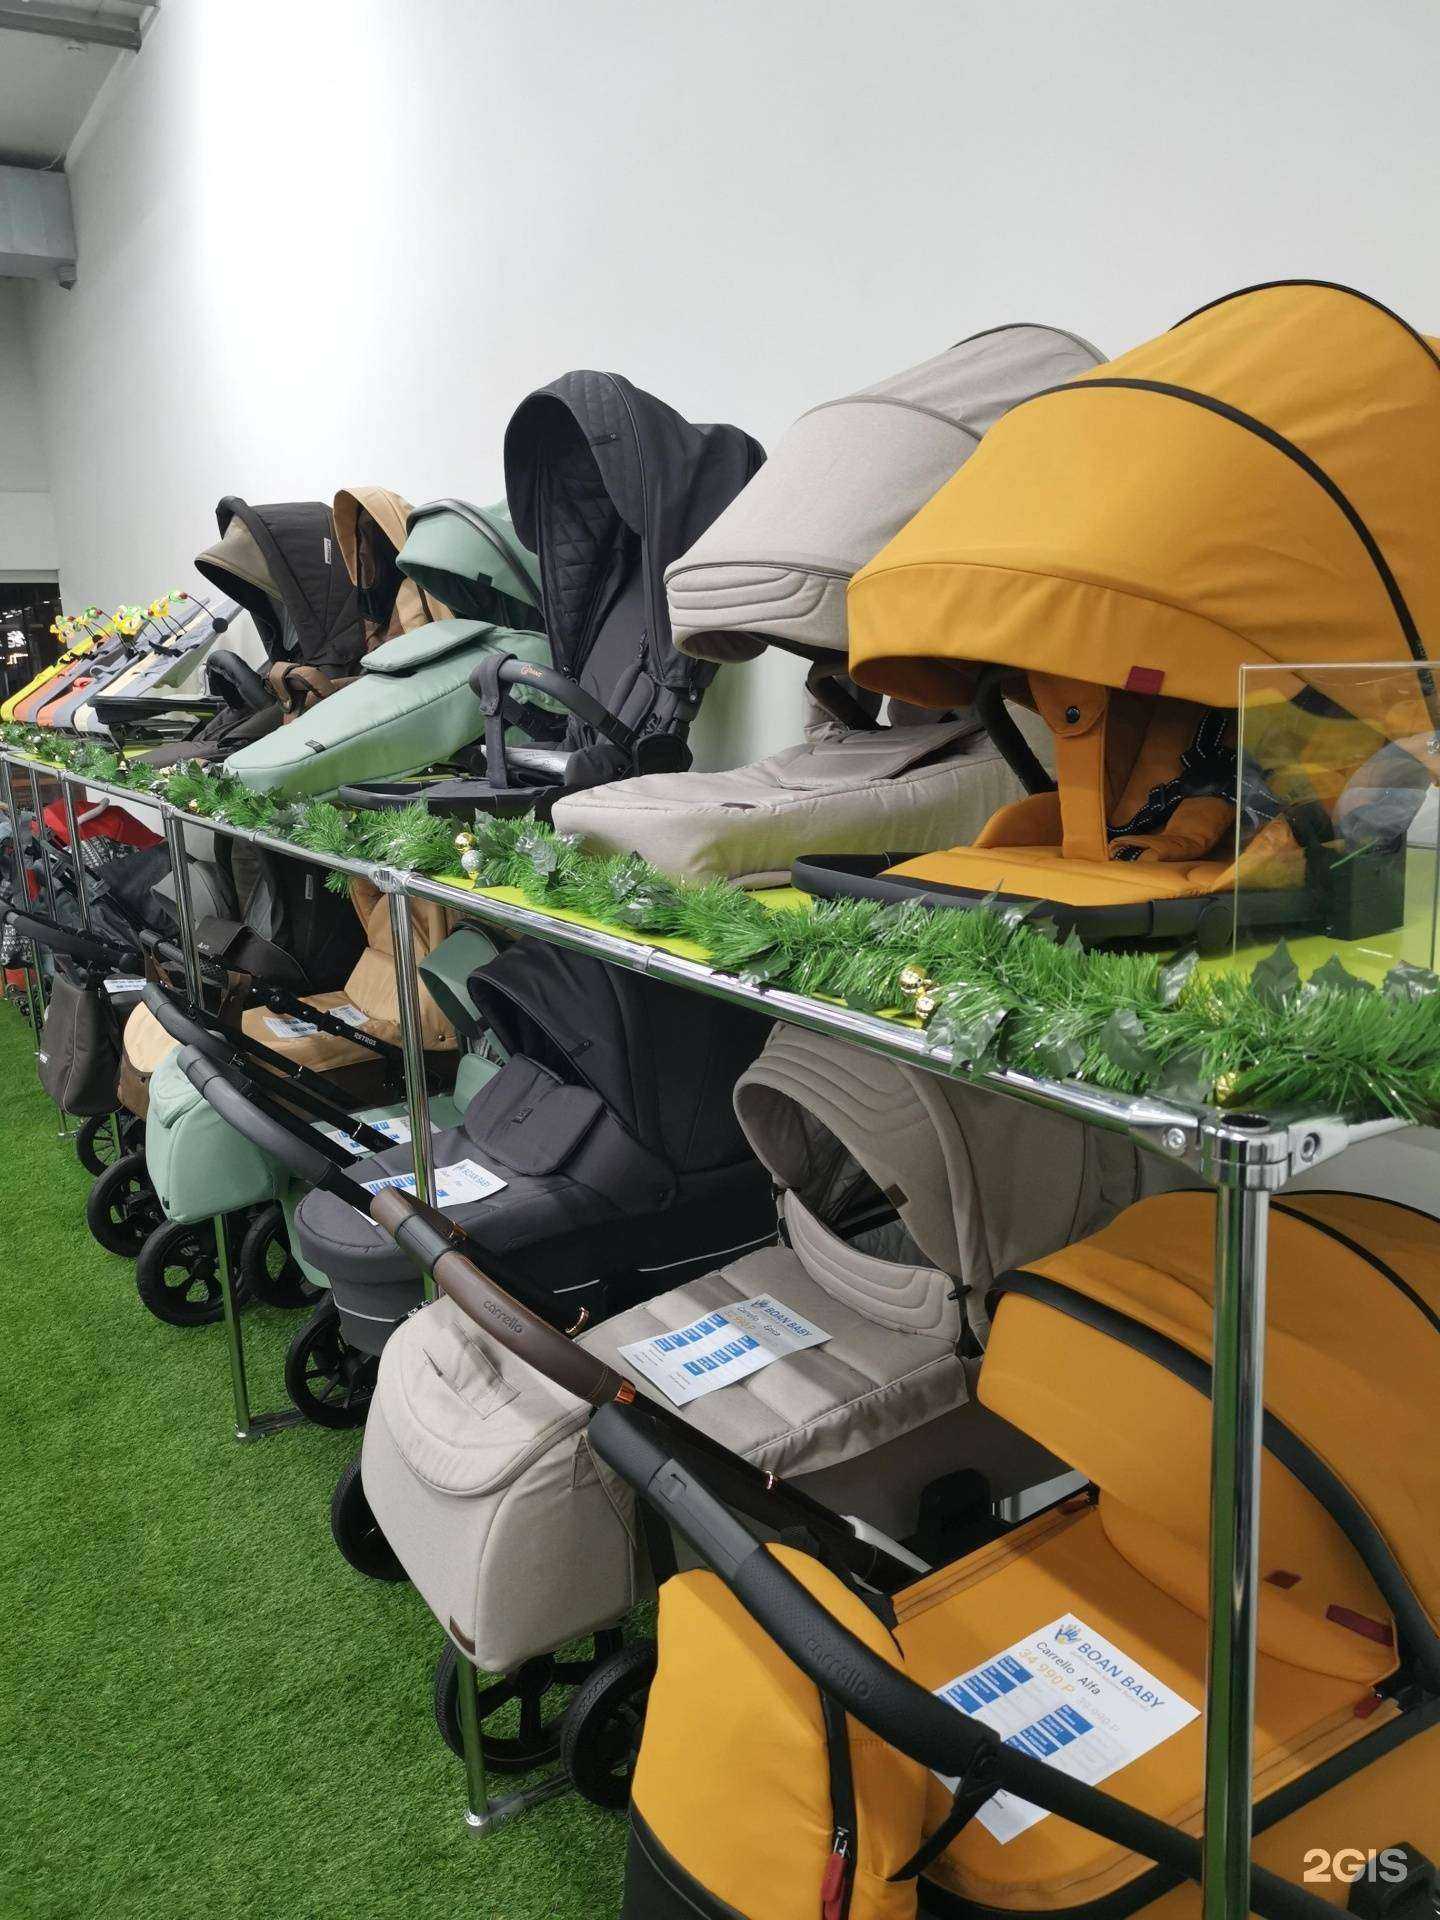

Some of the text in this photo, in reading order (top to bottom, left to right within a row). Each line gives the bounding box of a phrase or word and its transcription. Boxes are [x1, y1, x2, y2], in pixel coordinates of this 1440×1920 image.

[484, 1301, 522, 1333] carrello
[807, 1639, 872, 1700] carrello
[1037, 1642, 1075, 1674] Carrello
[1078, 1676, 1101, 1695] Alfa
[1078, 1643, 1122, 1677] BOAN
[1121, 1676, 1164, 1707] BABY
